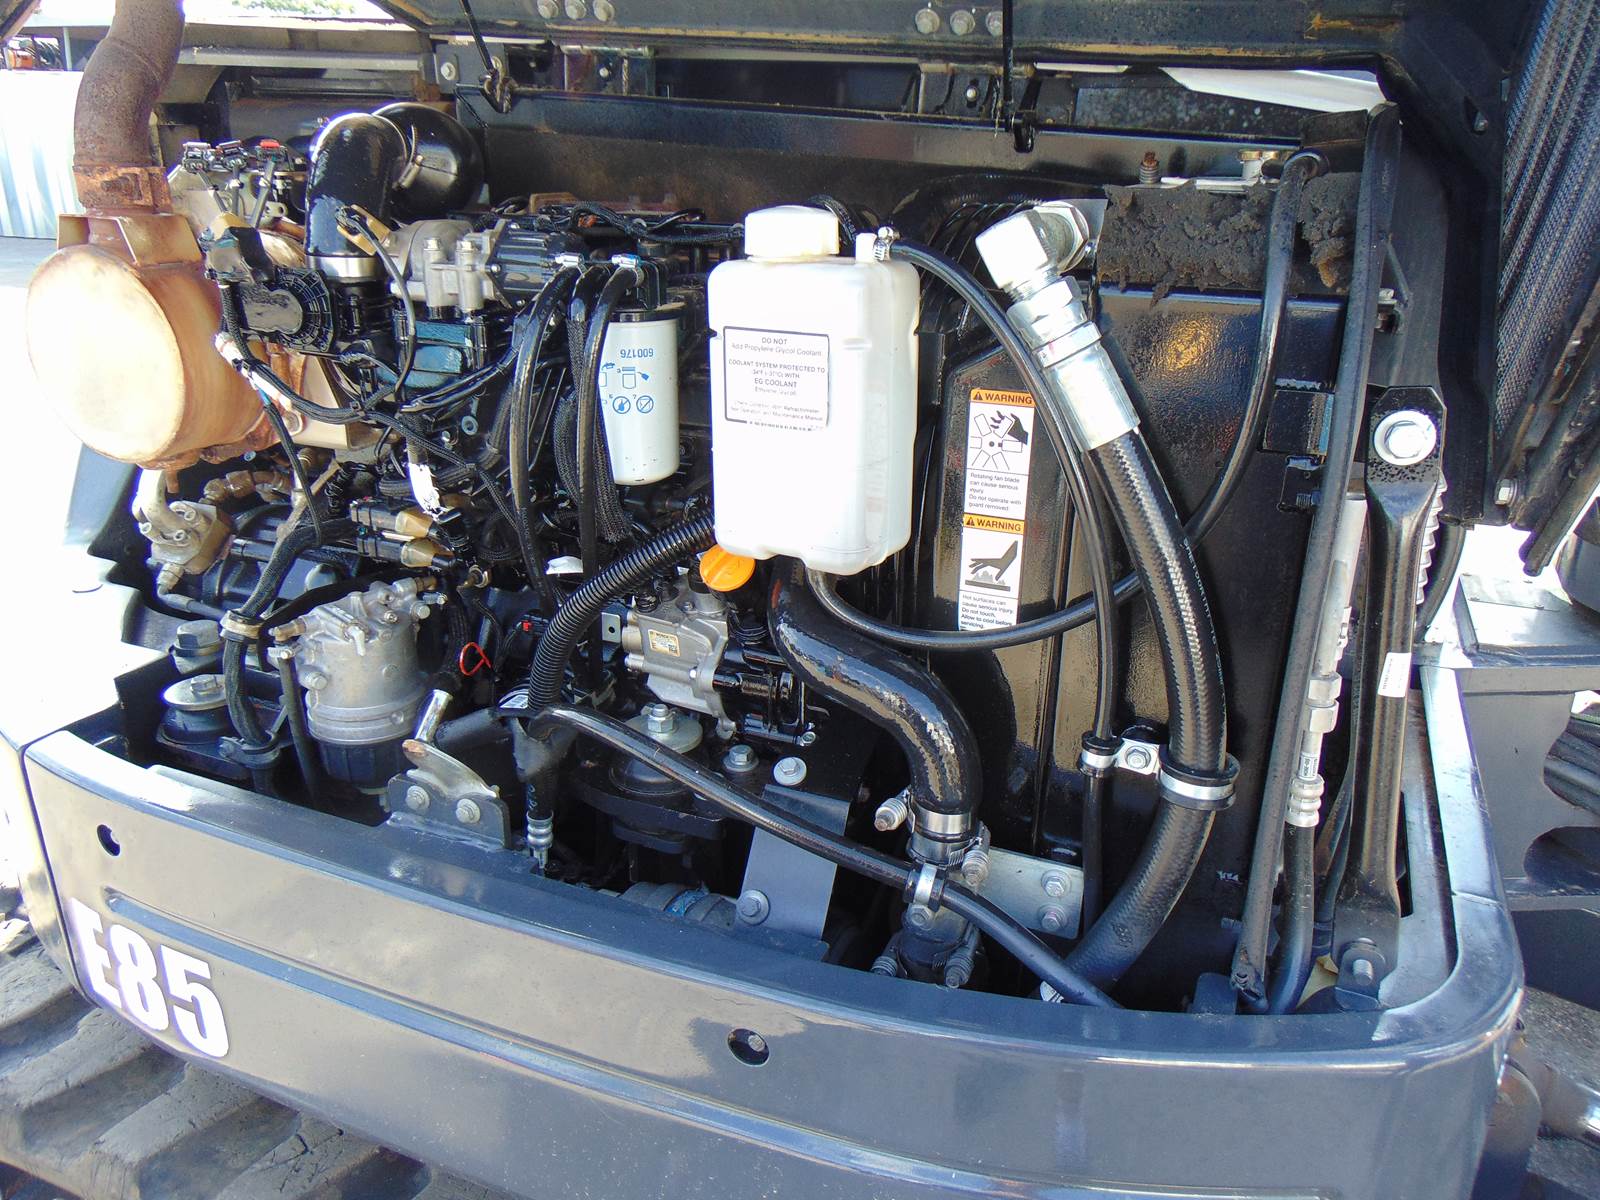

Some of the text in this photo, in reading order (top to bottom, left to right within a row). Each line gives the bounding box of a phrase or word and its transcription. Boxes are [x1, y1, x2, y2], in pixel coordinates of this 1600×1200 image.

[620, 348, 654, 359] 600176
[728, 359, 754, 367] COOLANT
[755, 361, 778, 369] SYSTEM
[779, 363, 816, 373] PROTECTED
[754, 377, 798, 389] EG COOLANT
[984, 392, 1033, 405] WARNING
[970, 472, 994, 481] Rotating
[976, 517, 1021, 532] WARNING
[961, 613, 976, 621] Allow
[70, 897, 230, 1059] E85
